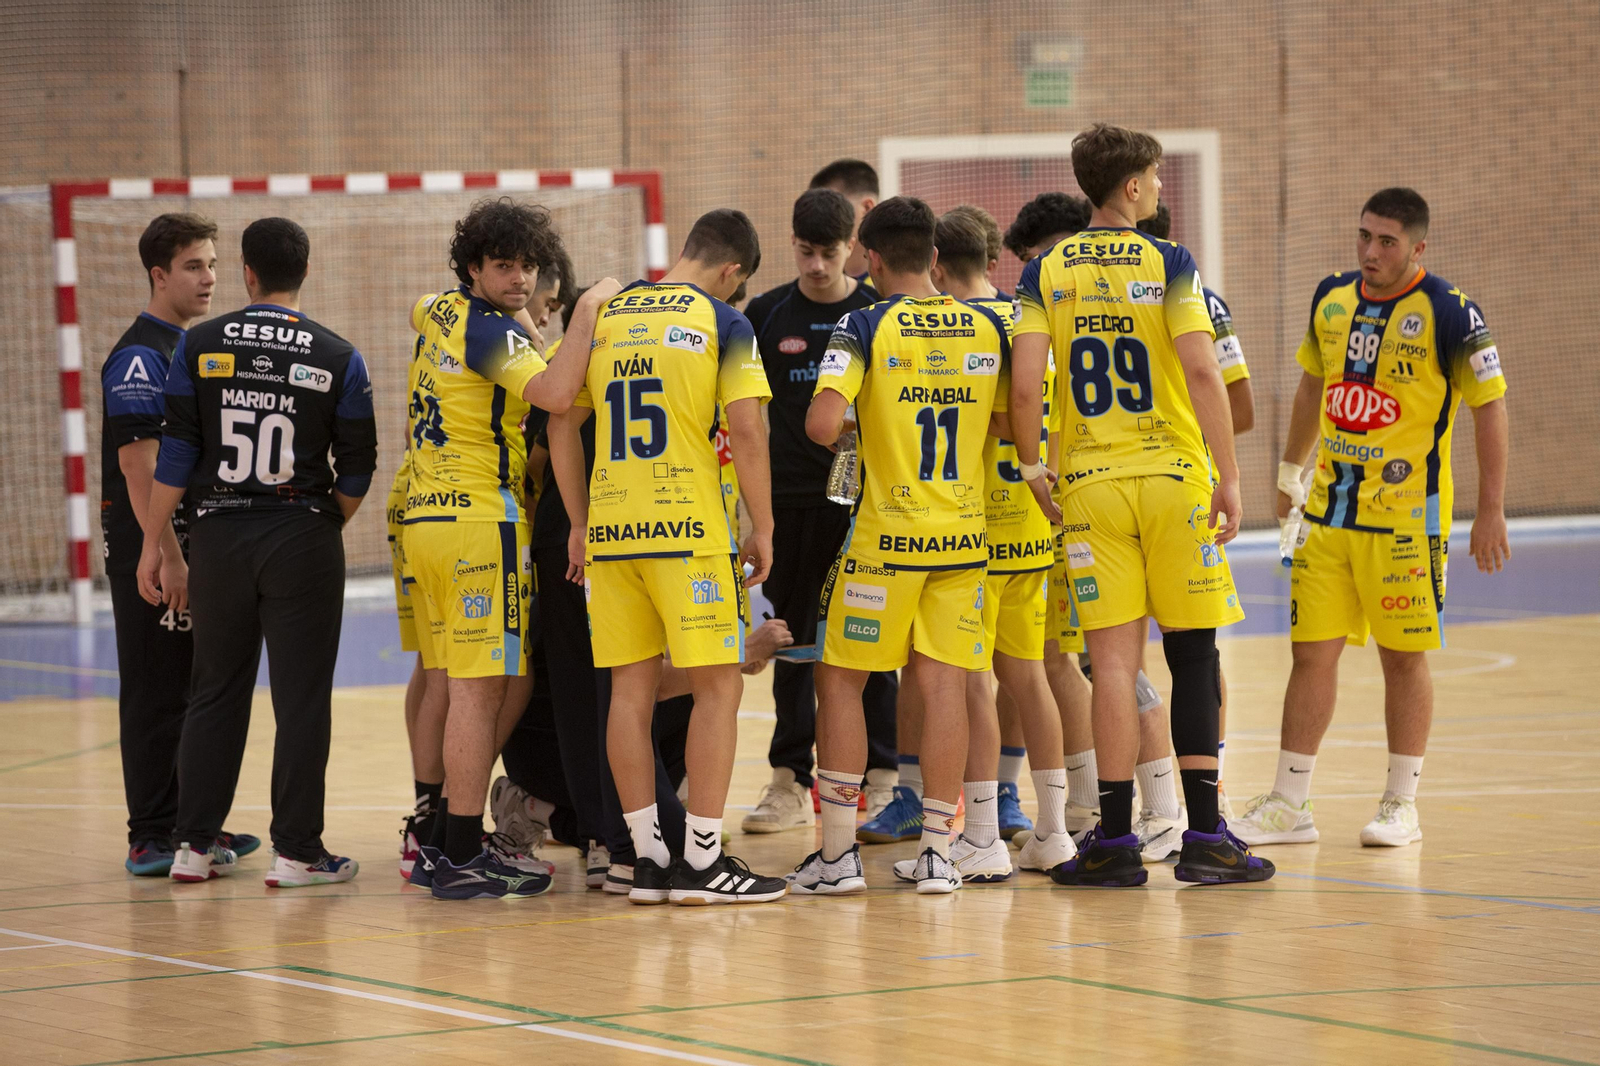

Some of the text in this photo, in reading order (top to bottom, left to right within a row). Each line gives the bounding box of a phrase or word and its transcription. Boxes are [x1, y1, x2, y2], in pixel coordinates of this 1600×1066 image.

[1063, 243, 1143, 259] CESUR
[608, 295, 696, 310] CESUR
[898, 312, 974, 329] CESUR
[1075, 315, 1134, 334] PEDRO
[224, 322, 313, 347] CESUR
[613, 339, 659, 349] HISPAMAROC
[234, 339, 260, 348] Centro
[261, 342, 287, 351] Oficial
[288, 345, 299, 353] de
[1348, 330, 1380, 365] 98
[614, 353, 653, 378] IVÁN
[237, 371, 285, 383] HISPAMAROC
[1069, 336, 1154, 418] 89
[222, 389, 297, 414] MARIO M.
[605, 378, 668, 461] 15
[218, 408, 295, 486] 50
[916, 406, 959, 482] 11
[589, 517, 705, 544] BENAHAVÍS
[879, 528, 988, 553] BENAHAVÍ
[457, 565, 489, 576] CLUSTER
[857, 564, 896, 577] smassa
[159, 609, 193, 631] 45
[848, 623, 878, 636] IELCO
